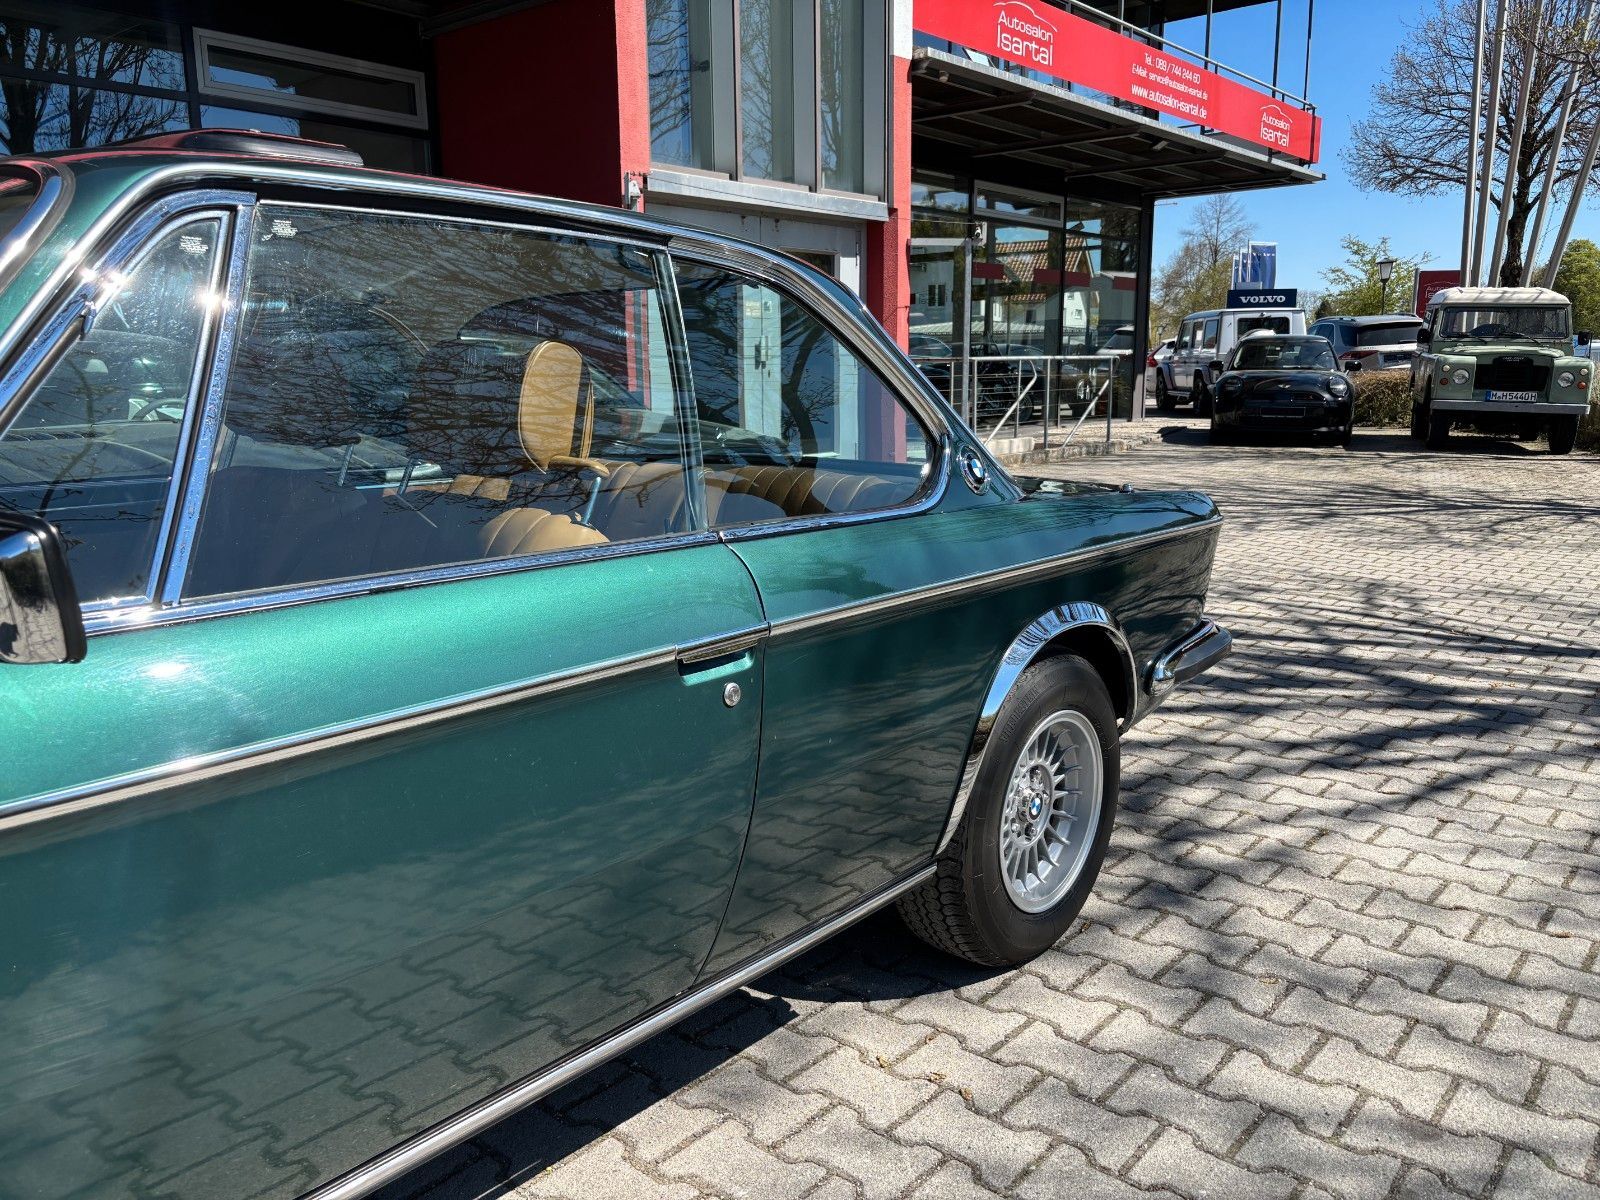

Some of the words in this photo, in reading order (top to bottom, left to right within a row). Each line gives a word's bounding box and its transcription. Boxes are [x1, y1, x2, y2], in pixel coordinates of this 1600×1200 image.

[998, 10, 1053, 43] Autosalon
[997, 24, 1053, 66] Isartal
[1155, 57, 1167, 72] 089
[1169, 63, 1182, 77] 744
[1182, 68, 1193, 82] 244
[1193, 72, 1201, 85] 60
[1148, 71, 1208, 101] service@autosalon-isartal.de
[1131, 83, 1207, 119] www.autosalon-isartal.de
[1260, 121, 1290, 148] Isartal
[1262, 112, 1290, 131] Autosalon
[1239, 295, 1286, 303] VOLVO
